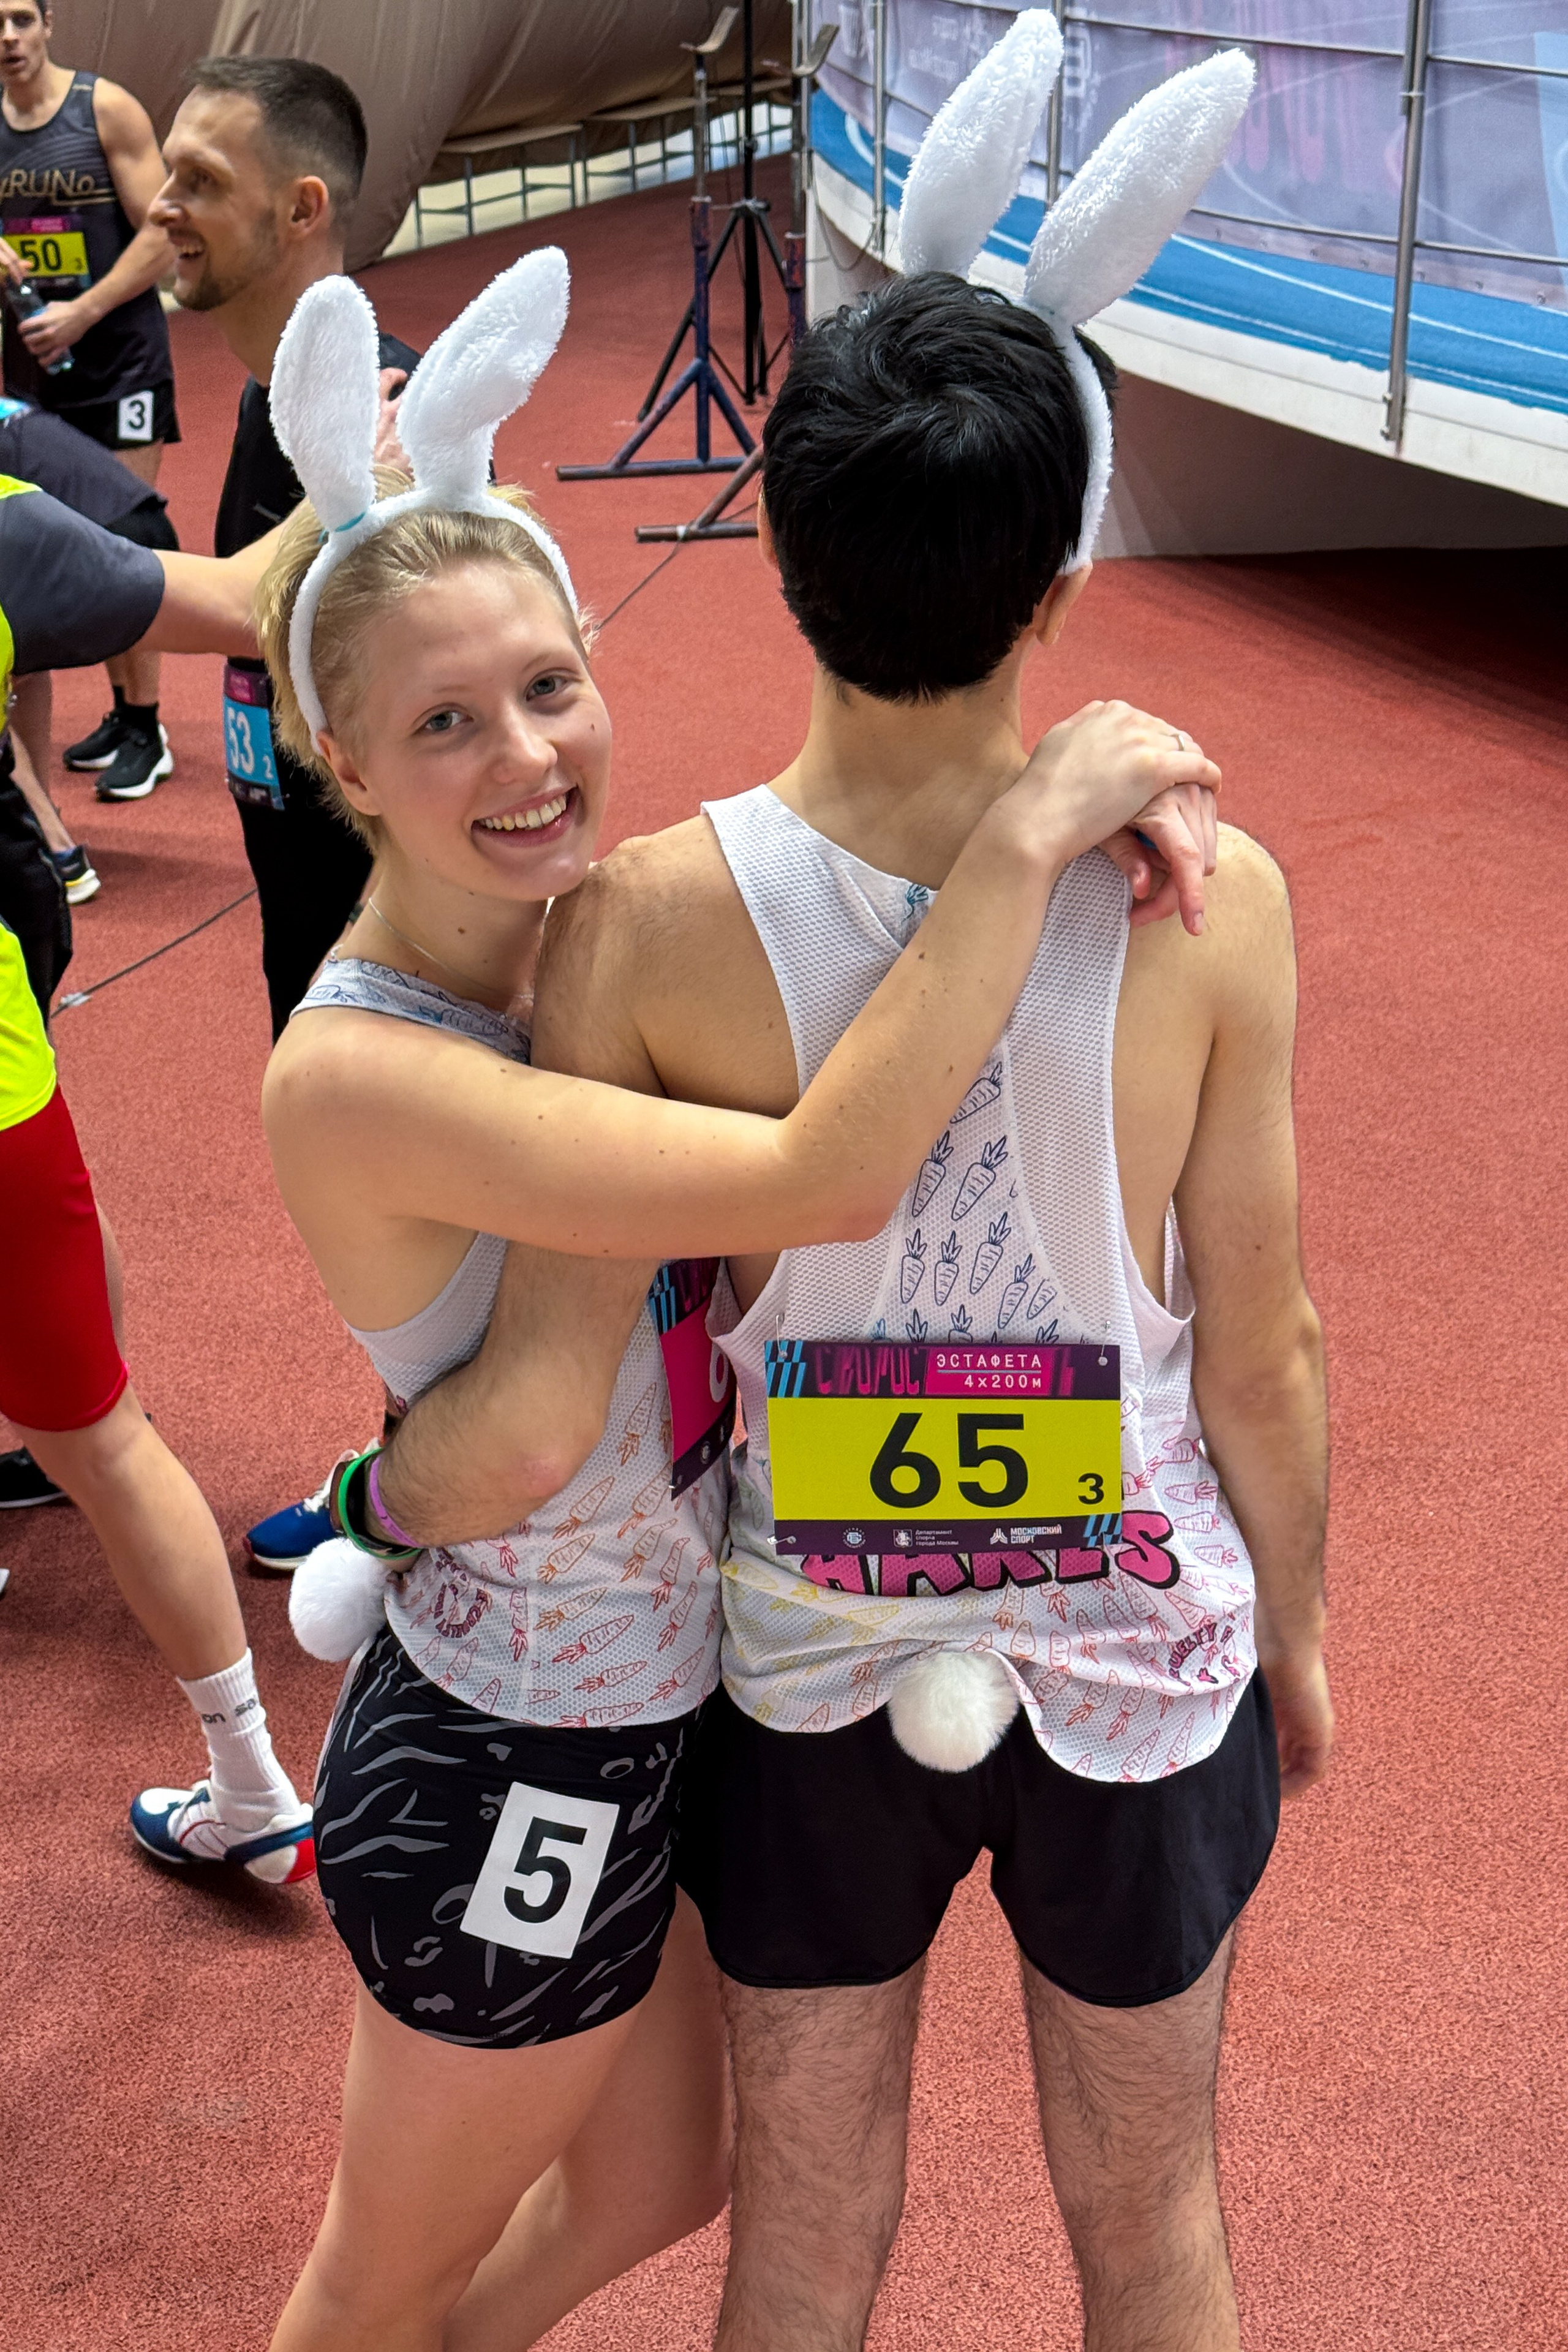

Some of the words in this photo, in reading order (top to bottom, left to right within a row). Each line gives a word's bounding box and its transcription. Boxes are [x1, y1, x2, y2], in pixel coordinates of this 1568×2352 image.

[20, 238, 62, 273] 50
[127, 399, 146, 430] 3
[936, 1353, 1042, 1368] ЭСТАФЕТА
[869, 1412, 1029, 1509] 65
[1077, 1472, 1104, 1505] 3
[1010, 1524, 1062, 1536] МОСКОВСКИЙ
[1010, 1535, 1035, 1545] СПОРТ
[503, 1815, 588, 1924] 5
